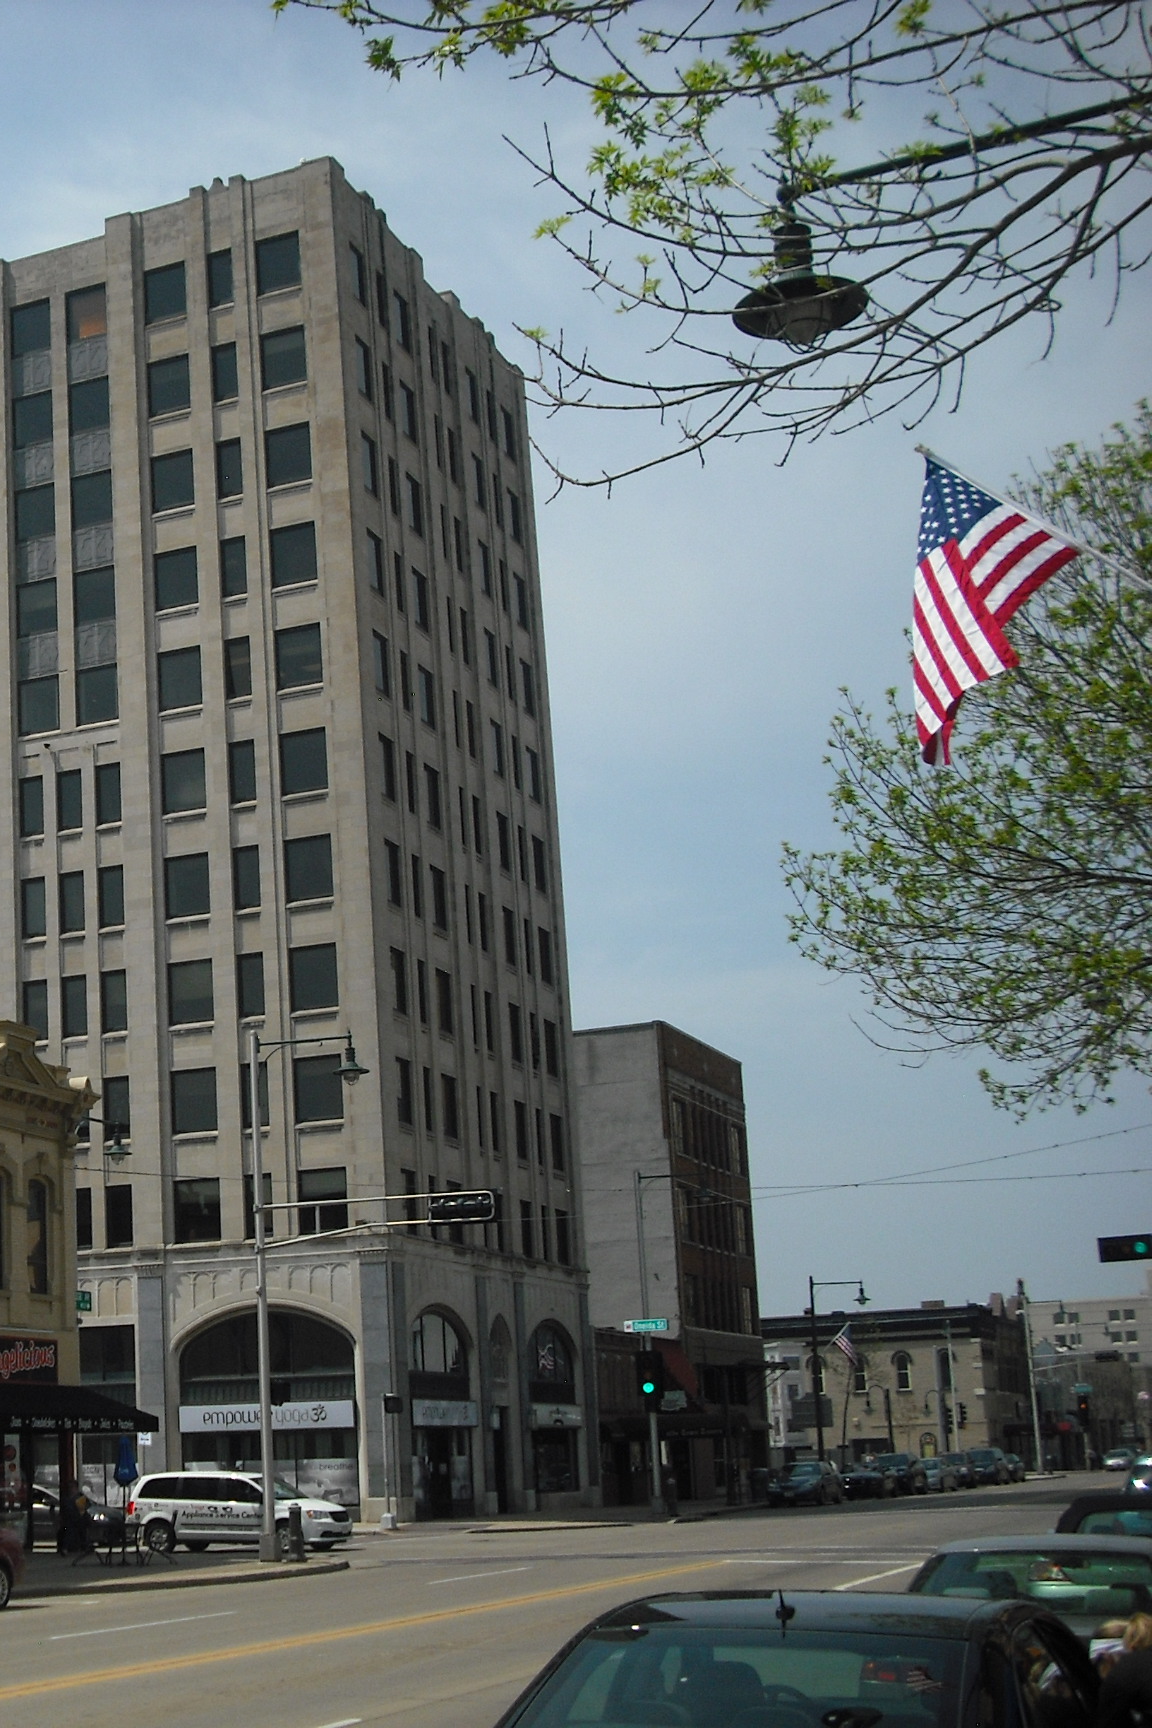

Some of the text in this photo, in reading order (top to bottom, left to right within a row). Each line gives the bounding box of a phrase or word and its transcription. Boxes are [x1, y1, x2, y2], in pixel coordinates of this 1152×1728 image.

[202, 1409, 309, 1427] empowe yoga
[318, 1463, 353, 1472] breathe
[181, 1510, 214, 1520] Appliance
[215, 1511, 240, 1520] Service
